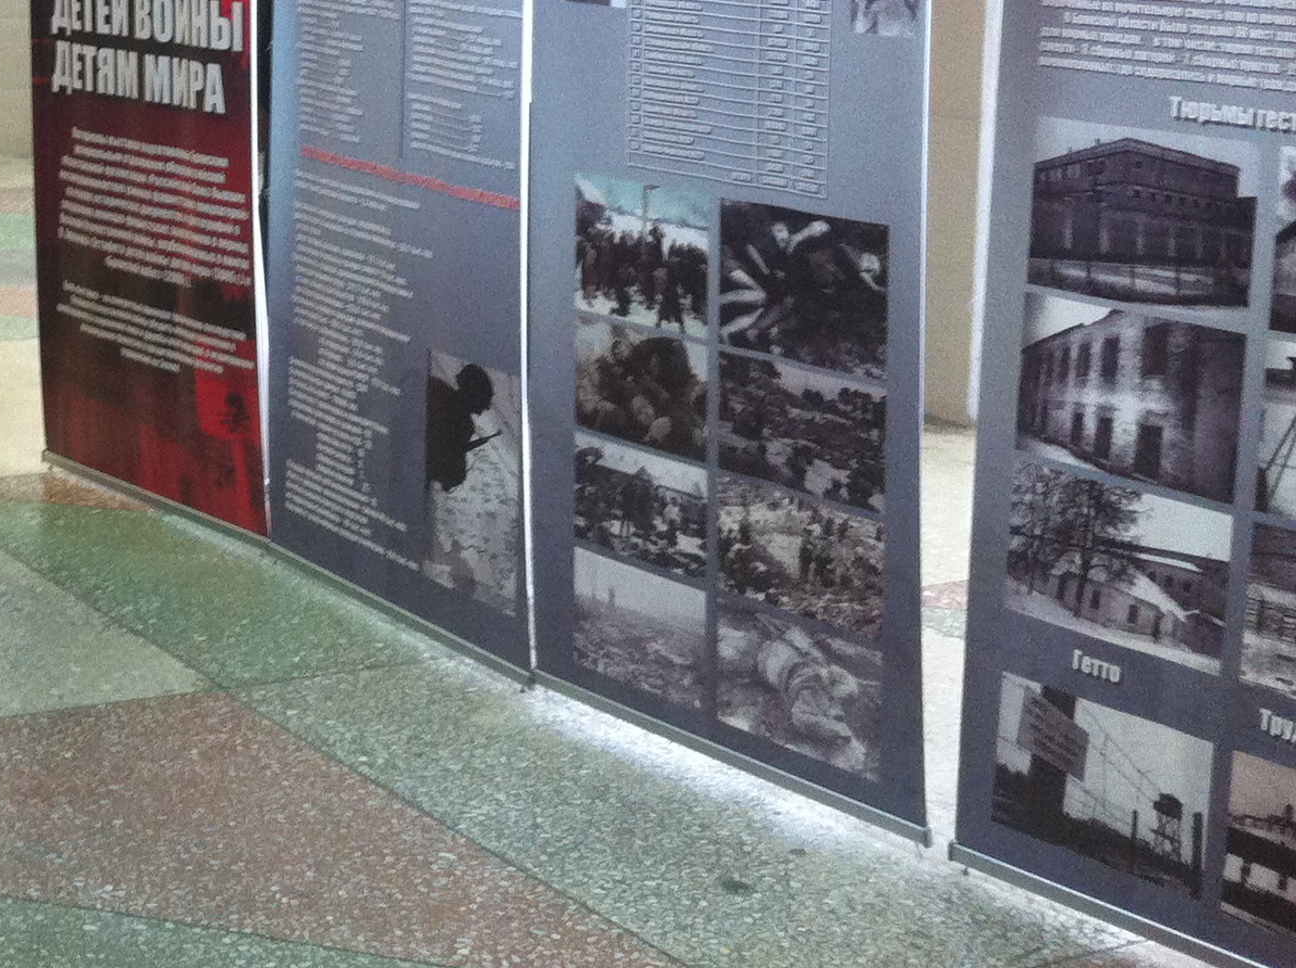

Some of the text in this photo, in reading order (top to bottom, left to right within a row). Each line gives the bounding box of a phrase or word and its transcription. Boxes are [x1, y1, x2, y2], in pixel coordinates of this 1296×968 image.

[51, 40, 226, 115] ДЕТЯМ МИРА
[1071, 649, 1121, 683] Гетто
